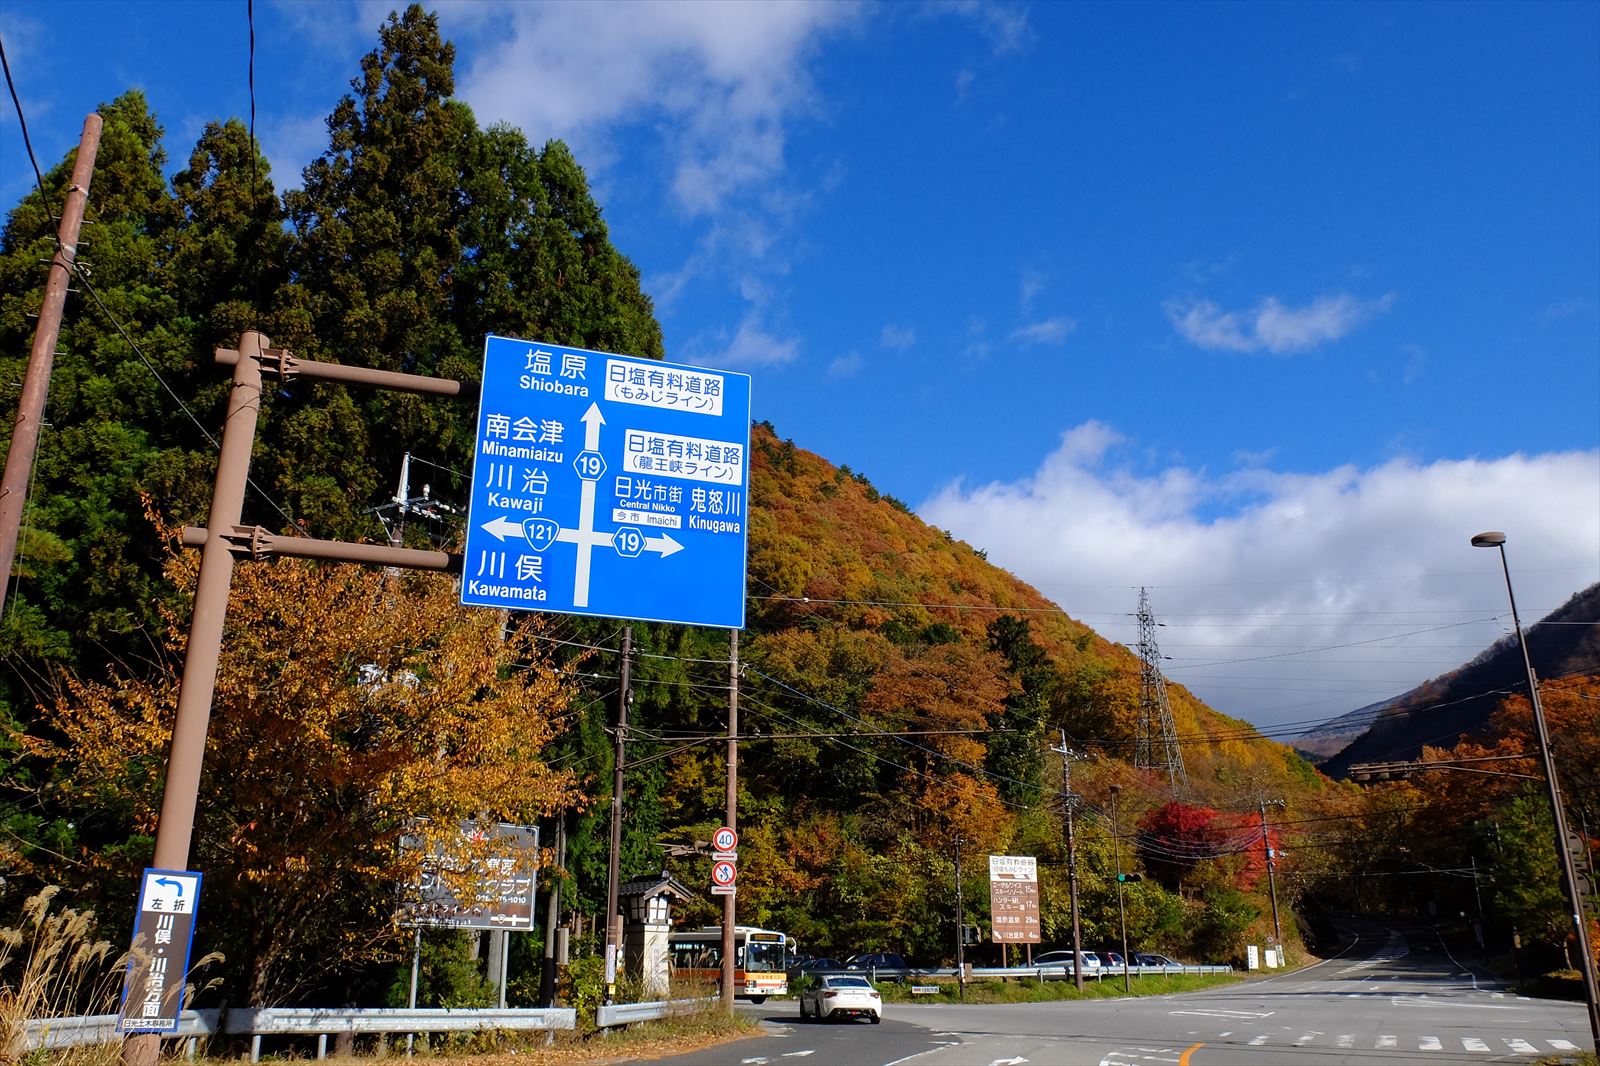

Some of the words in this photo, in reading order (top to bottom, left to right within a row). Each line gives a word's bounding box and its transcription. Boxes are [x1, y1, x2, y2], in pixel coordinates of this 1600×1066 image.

[525, 349, 587, 380] 塩原
[519, 375, 589, 398] Shiobara
[610, 364, 721, 397] 日塩有料道路
[614, 383, 714, 411] (もみじライン)
[486, 413, 564, 445] 南会津
[482, 440, 564, 463] Minamiaizu
[628, 434, 740, 466] 日塩有料道路
[580, 457, 600, 476] 19
[632, 454, 734, 481] (龍王峡ライン)
[485, 462, 549, 495] 川治
[615, 475, 683, 504] 日光市街
[488, 492, 543, 512] Kawaji
[620, 499, 650, 510] Central
[652, 502, 676, 513] Nikko
[690, 486, 741, 517] 鬼怒川
[617, 511, 640, 522] 今市
[647, 514, 678, 526] Imaichi
[689, 514, 741, 534] Kinugawa
[528, 523, 552, 541] 121
[619, 532, 640, 552] 19
[477, 550, 543, 582] 川俣
[468, 580, 547, 601] Kawamata
[718, 834, 733, 847] 40
[151, 898, 185, 912] 左折
